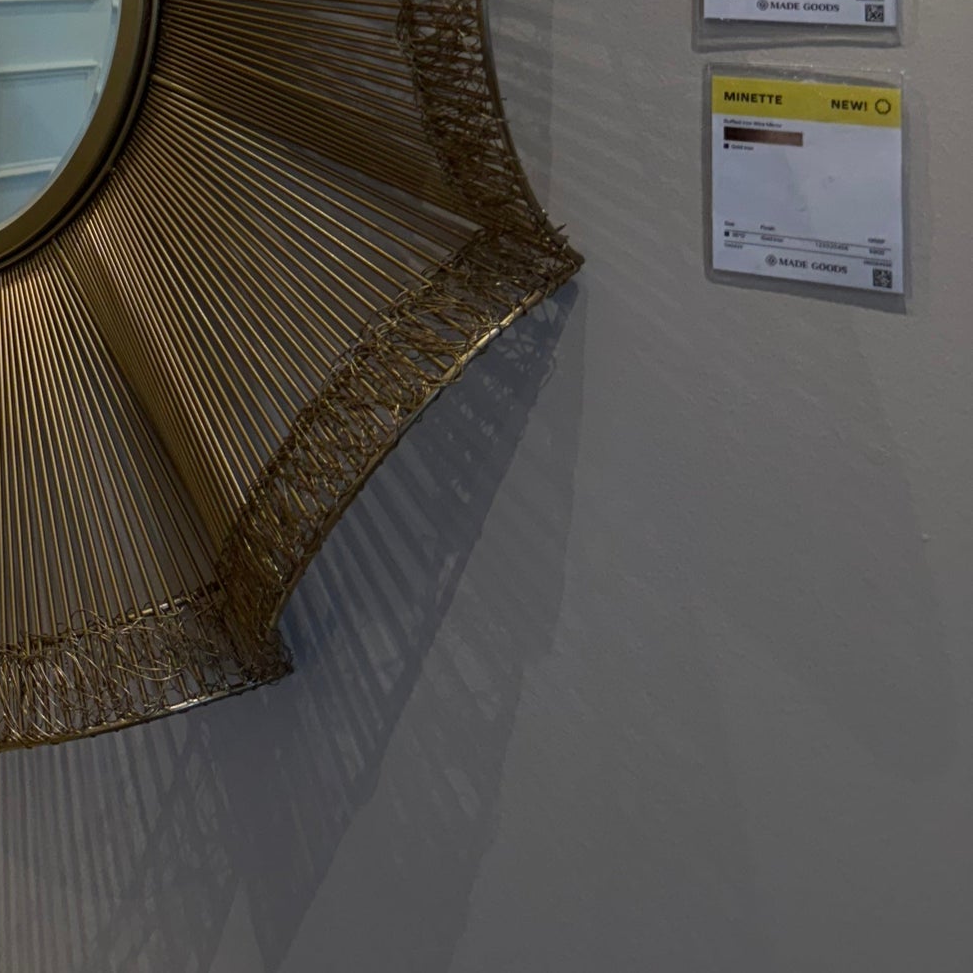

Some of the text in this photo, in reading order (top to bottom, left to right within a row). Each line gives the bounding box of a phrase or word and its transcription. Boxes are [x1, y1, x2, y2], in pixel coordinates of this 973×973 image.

[770, 1, 840, 12] MADE GOODS
[723, 91, 868, 112] MINETTE NEW!
[779, 258, 848, 275] MADE GOODS
